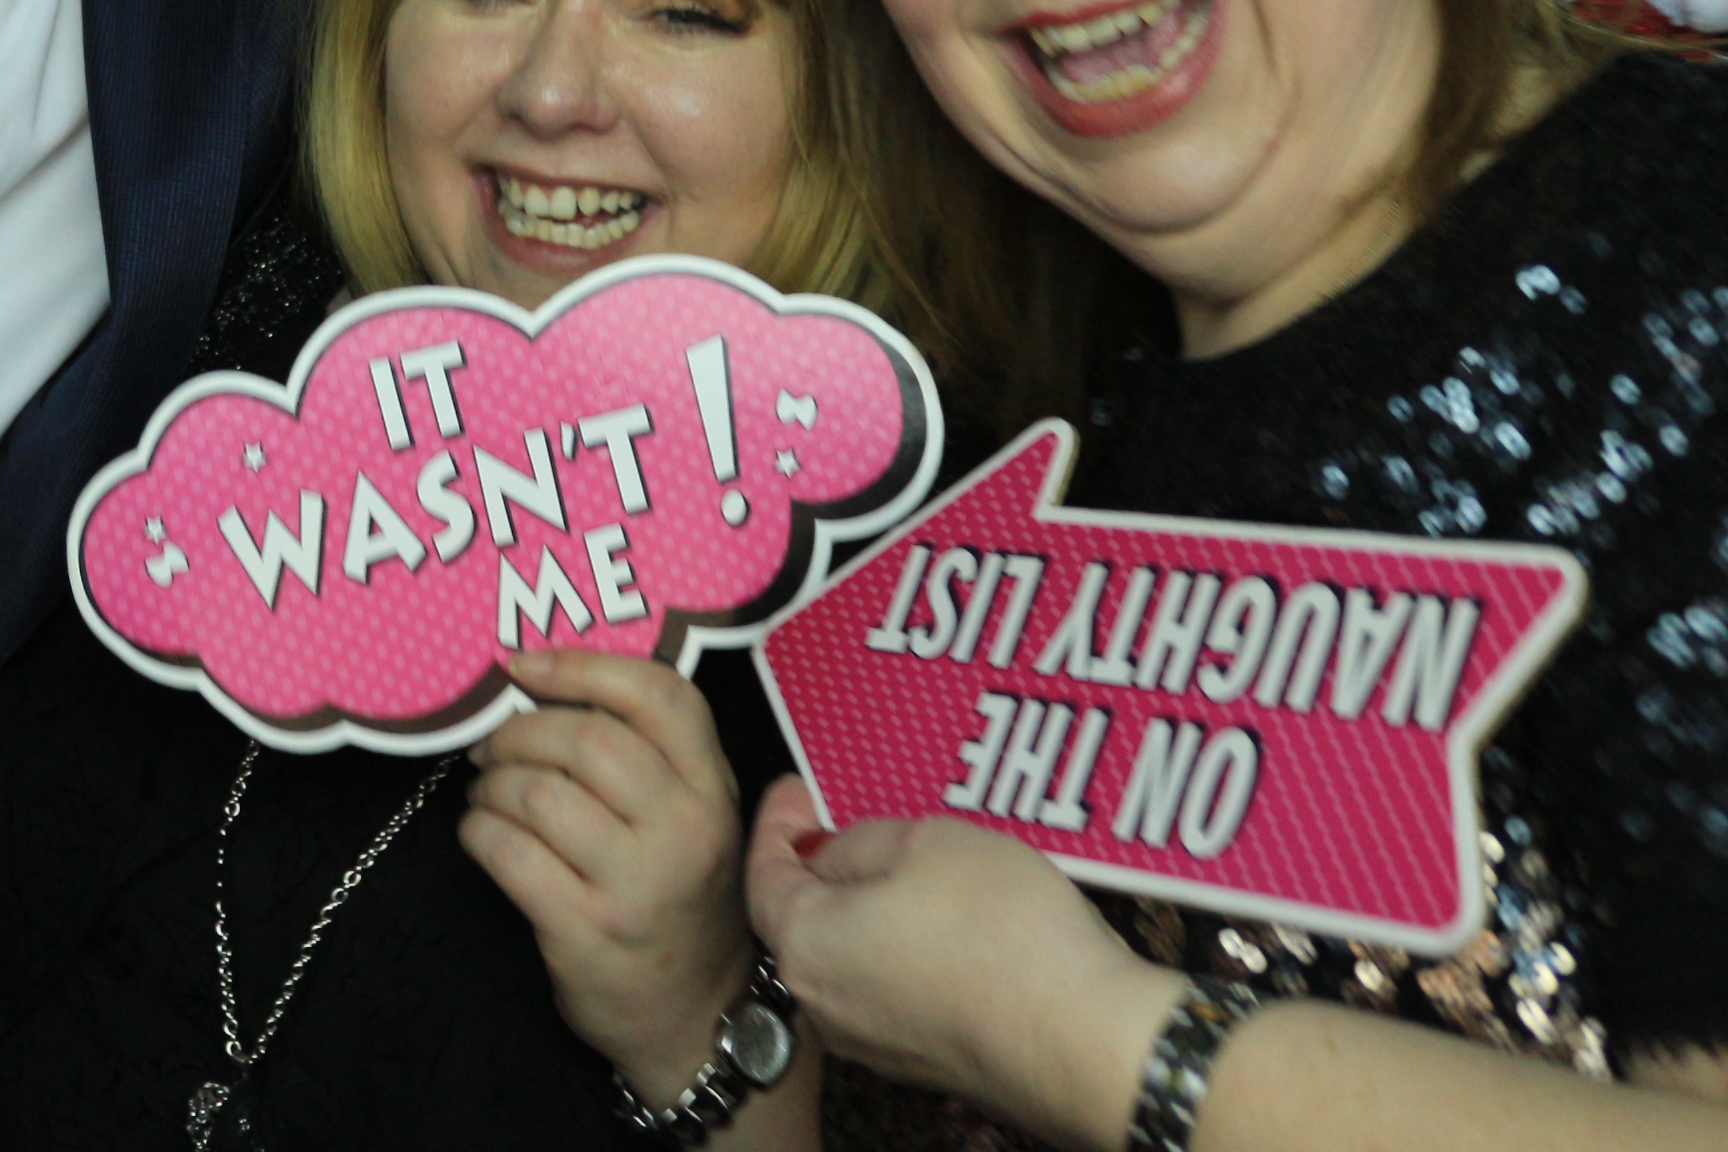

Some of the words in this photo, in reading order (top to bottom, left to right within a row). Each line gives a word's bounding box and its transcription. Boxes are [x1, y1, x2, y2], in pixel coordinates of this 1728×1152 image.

[369, 339, 467, 451] IT
[217, 403, 653, 610] WASN'T
[497, 522, 649, 649] ME
[864, 542, 1048, 670] LIST
[1032, 559, 1483, 732] NAUGHTY
[943, 690, 1111, 831] THE
[1112, 715, 1263, 860] ON
